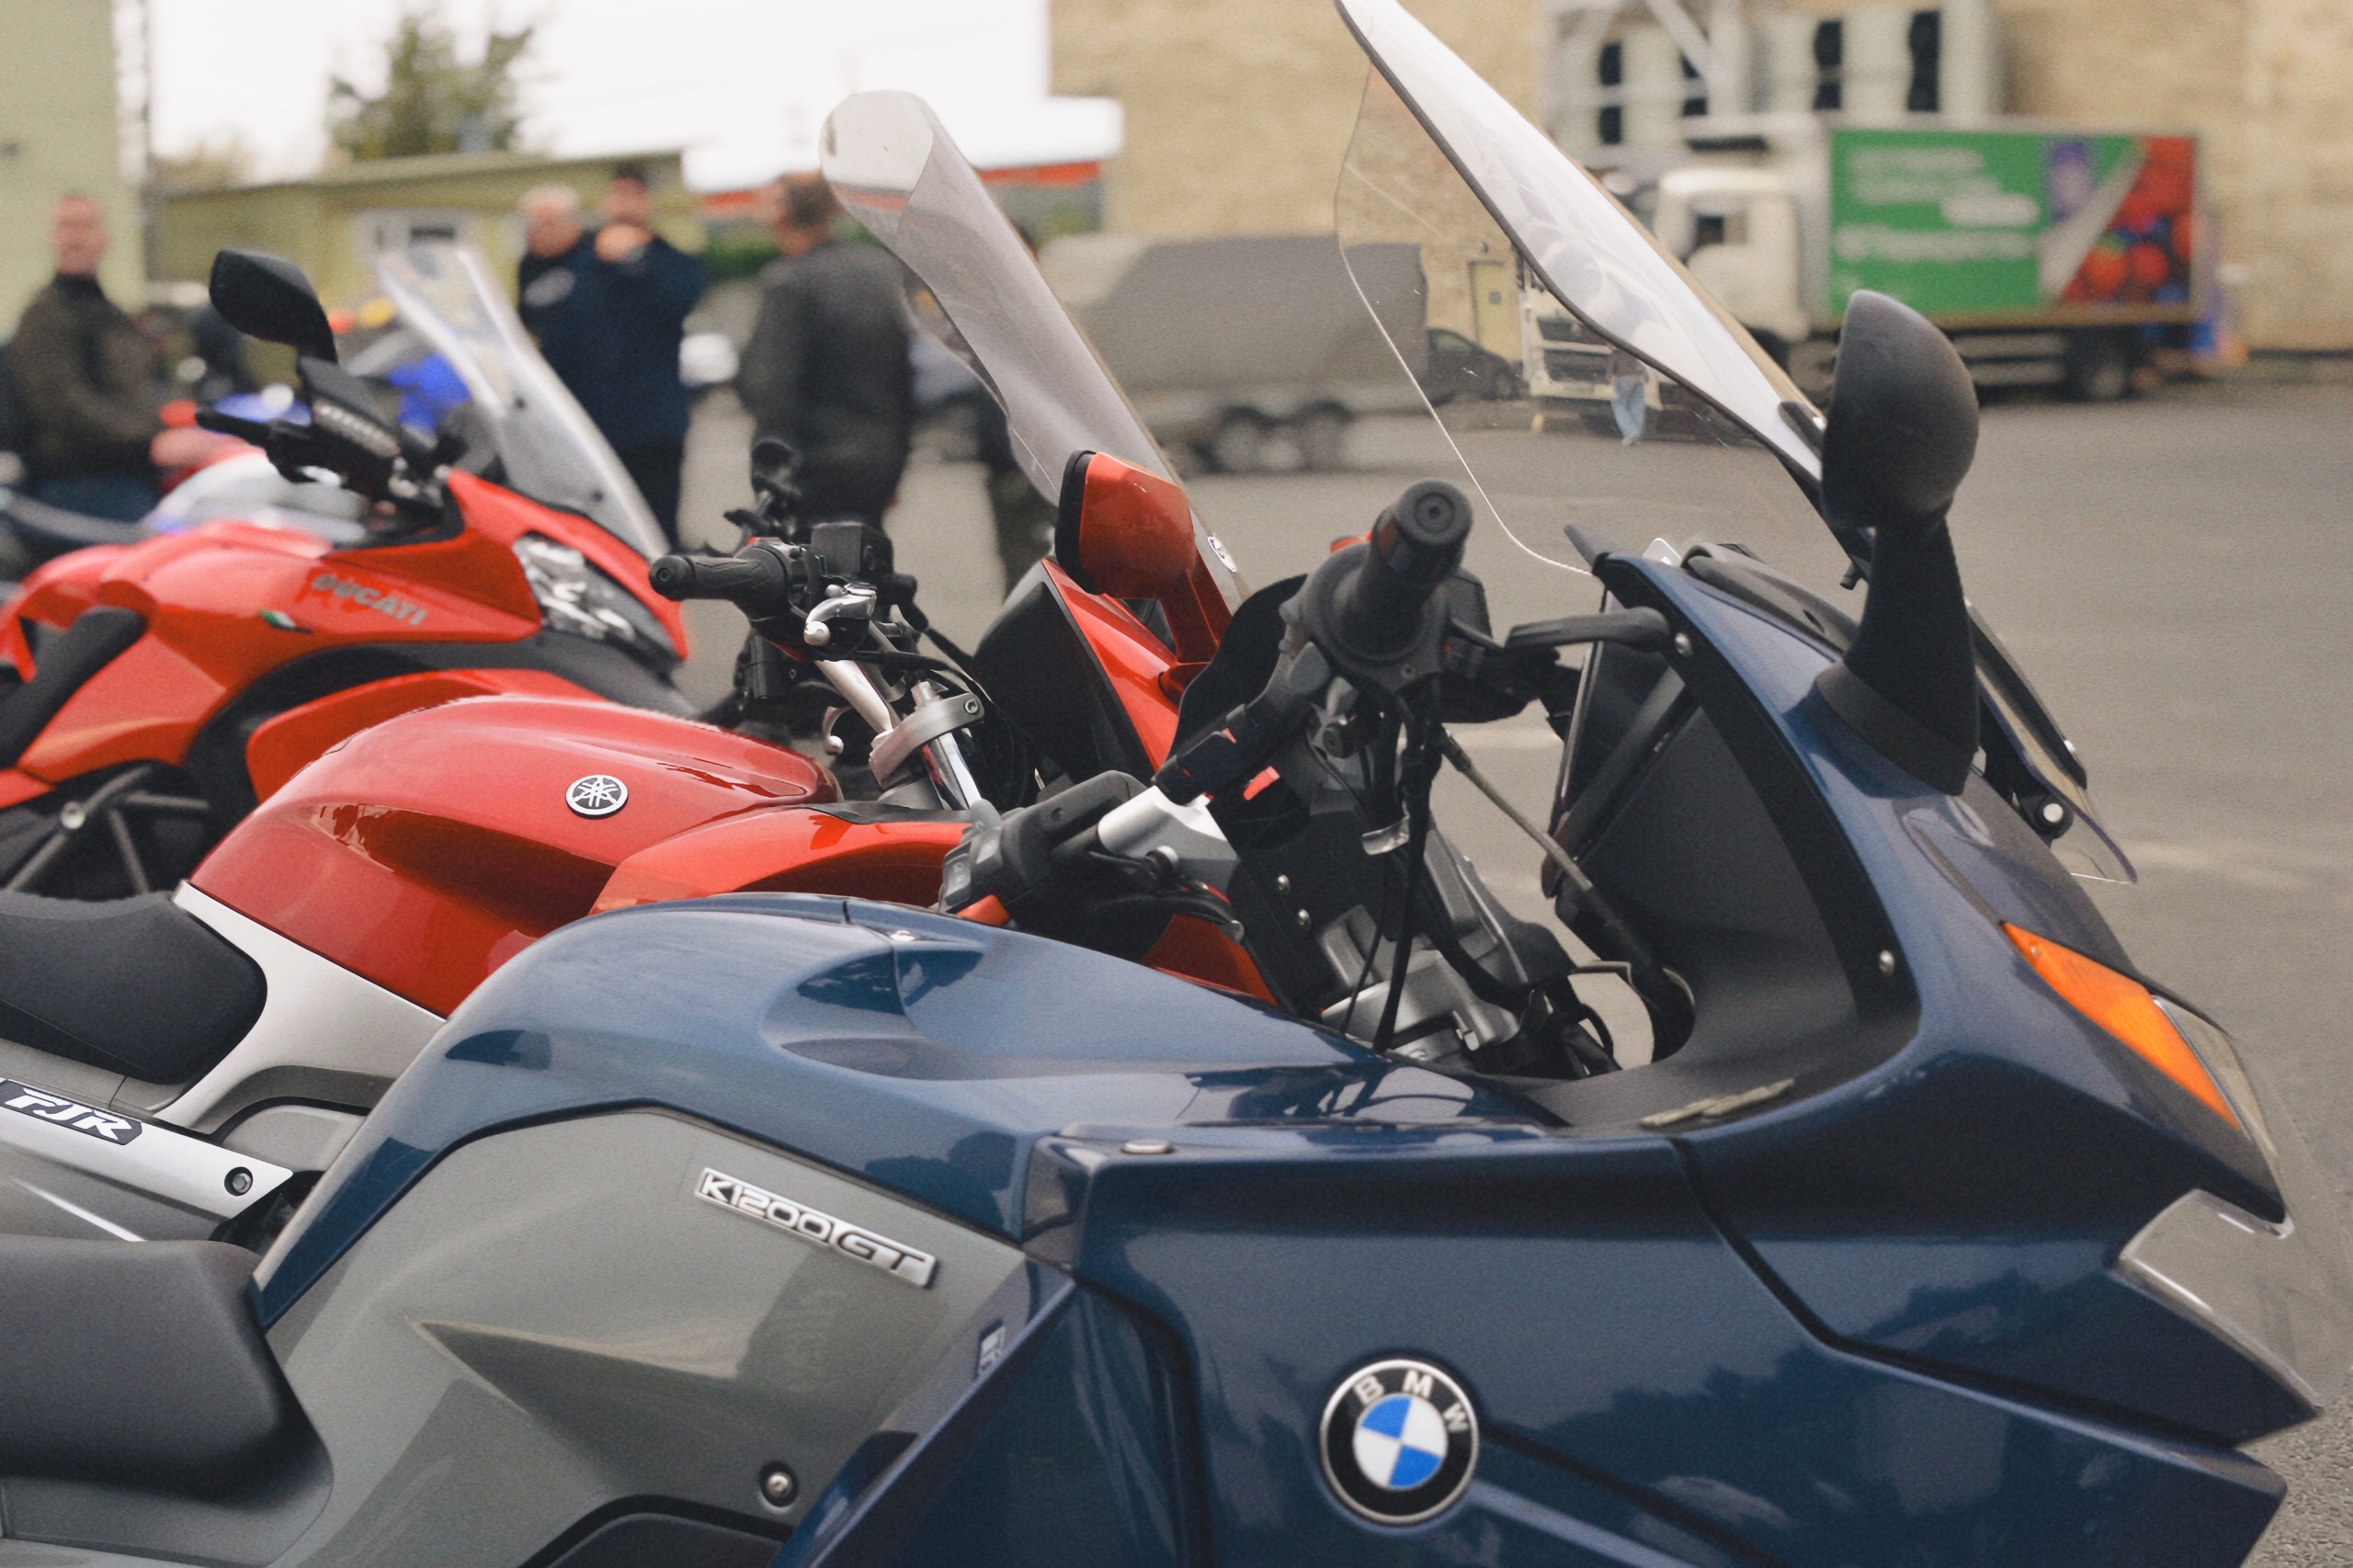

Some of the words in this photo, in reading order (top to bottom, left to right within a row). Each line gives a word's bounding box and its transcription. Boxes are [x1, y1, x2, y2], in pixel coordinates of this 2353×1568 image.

[311, 574, 427, 626] DUCATI
[5, 1087, 132, 1141] FJR
[1354, 1369, 1469, 1433] BMW
